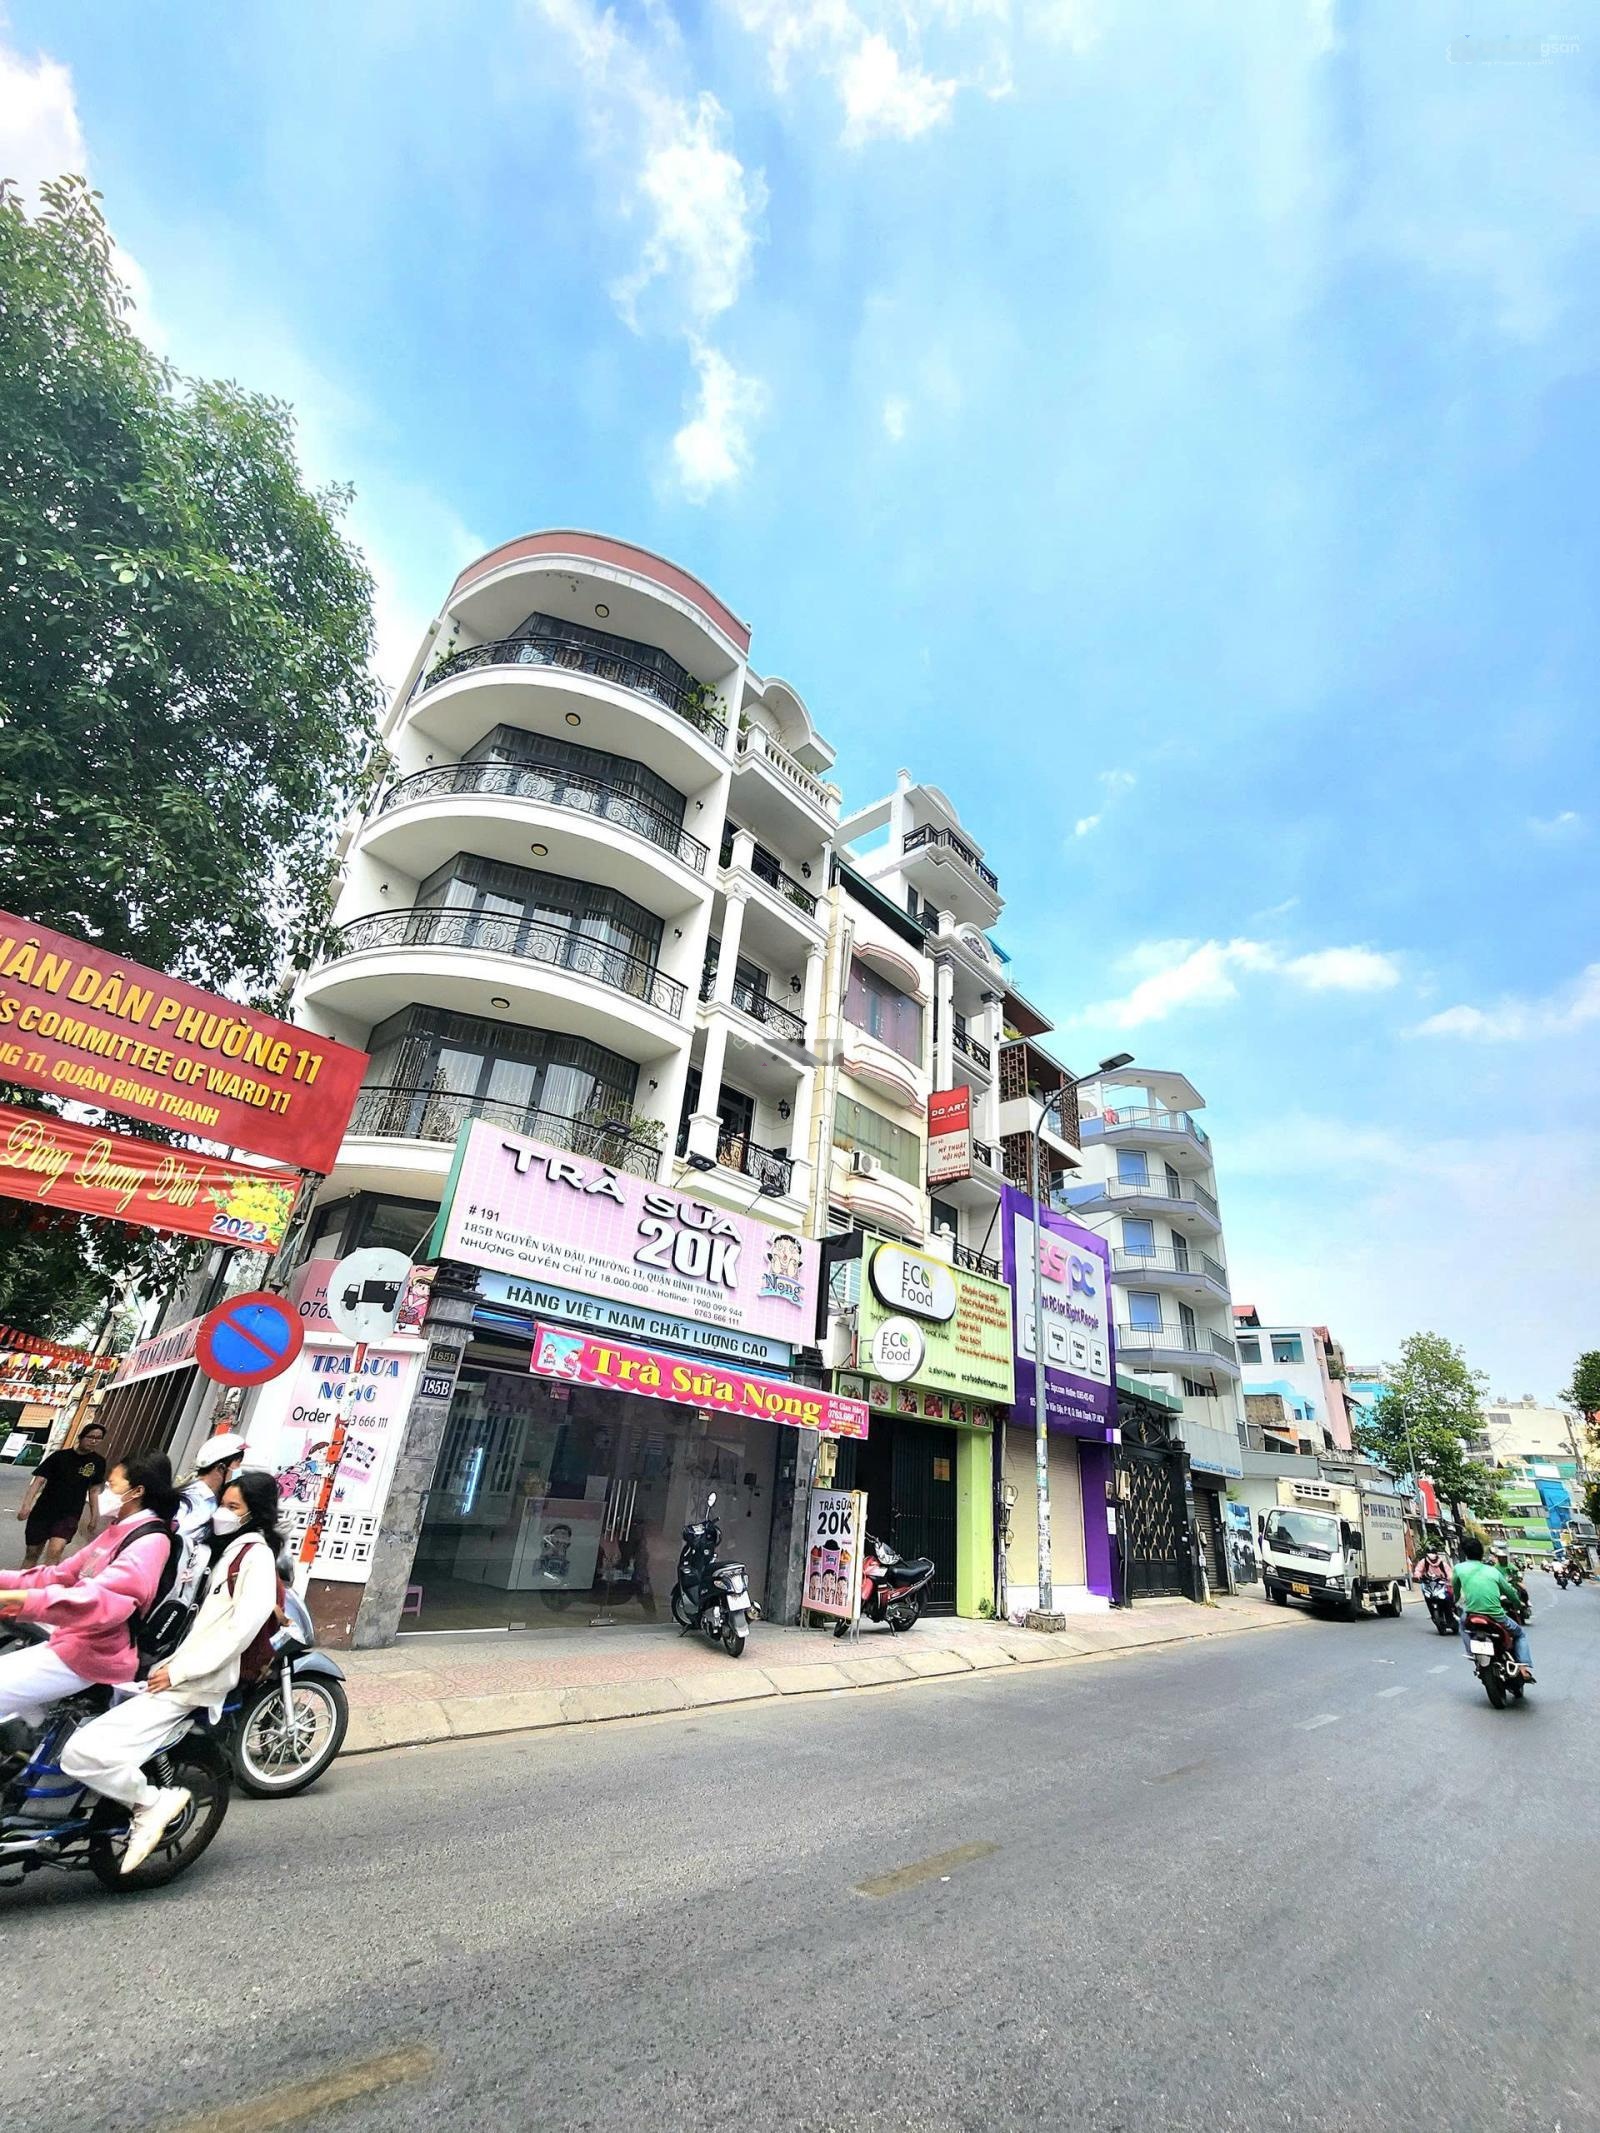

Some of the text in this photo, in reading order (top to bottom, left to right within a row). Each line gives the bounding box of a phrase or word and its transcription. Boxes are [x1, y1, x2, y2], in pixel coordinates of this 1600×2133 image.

[67, 966, 154, 1024] DÂN
[149, 996, 292, 1075] PHƯỜNG
[293, 1050, 323, 1085] 11
[18, 1005, 175, 1076] COMMITTEE
[172, 1057, 207, 1085] OF
[205, 1067, 271, 1108] WARD
[269, 1090, 292, 1114] 11
[23, 1051, 48, 1077] 11,
[51, 1059, 112, 1094] QUẬN
[109, 1077, 160, 1107] BÌNH
[158, 1092, 221, 1127] THẠNH
[948, 1101, 967, 1113] ART
[74, 1137, 147, 1213] Quang
[147, 1156, 207, 1208] Vinh
[502, 1141, 627, 1206] TRÀ
[209, 1212, 268, 1243] 2023
[480, 1207, 500, 1222] 191
[463, 1221, 493, 1237] 185B
[495, 1230, 540, 1249] NGUYỄN
[542, 1241, 562, 1256] VĂN
[588, 1255, 631, 1275] PHƯỜNG
[646, 1271, 672, 1287] QUẬN
[672, 1277, 695, 1292] BÌNH
[695, 1285, 723, 1301] THẠNH
[634, 1218, 743, 1288] 20K
[460, 1236, 515, 1257] NHƯỢNG
[562, 1263, 582, 1276] CHỈ
[600, 1273, 649, 1293] 18.000.000
[693, 1297, 711, 1309] 1900
[712, 1302, 728, 1314] 099
[900, 1282, 933, 1308] Food
[505, 1283, 768, 1358] HÀNG VIỆT NAM CHẤT LƯỢNG CAO
[694, 1308, 712, 1320] 0763
[728, 1316, 740, 1326] 111
[433, 1350, 456, 1362] 185B
[880, 1348, 911, 1361] Food
[422, 1379, 450, 1396] 185B
[589, 1344, 823, 1427] Trà Sữa Nọng
[292, 1406, 332, 1424] Order
[358, 1415, 375, 1428] 666
[377, 1417, 389, 1429] 111
[819, 1497, 853, 1512] TRÀ SỮA
[816, 1511, 852, 1535] 20K
[1289, 1549, 1310, 1558] ISUZU
